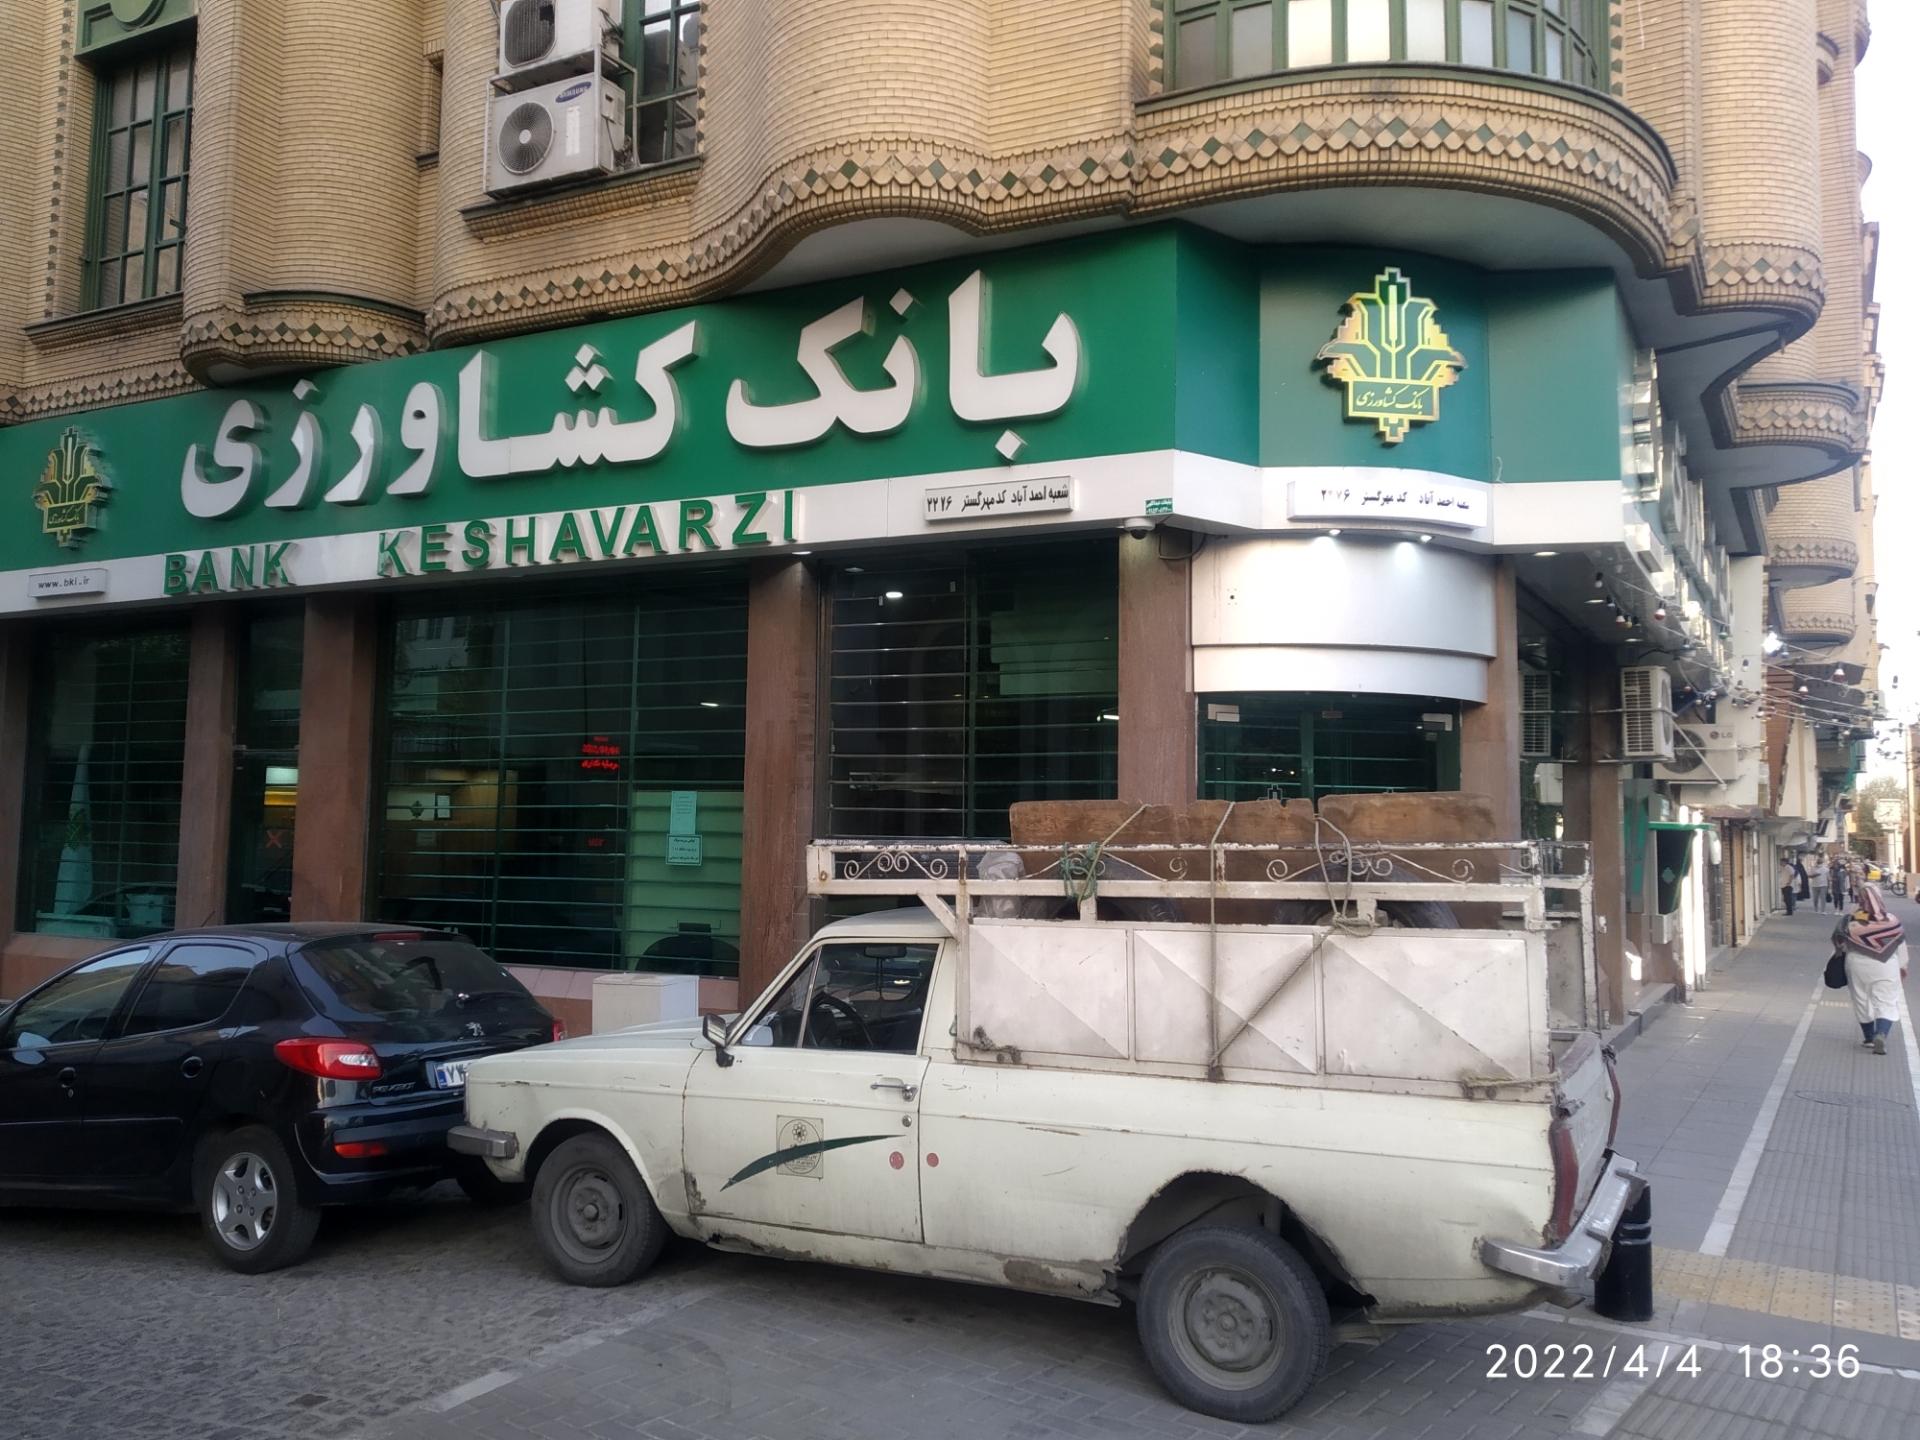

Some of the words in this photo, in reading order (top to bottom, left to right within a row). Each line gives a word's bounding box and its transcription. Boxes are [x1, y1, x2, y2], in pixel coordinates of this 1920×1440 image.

[726, 269, 1080, 461] بانک
[1356, 384, 1410, 408] کشاورزی
[1395, 386, 1430, 415] بانک
[181, 319, 699, 518] کشاورزی
[926, 495, 953, 512] ۲۲۷۶
[961, 490, 995, 512] مهرگستر
[996, 489, 1007, 504] کد
[1011, 485, 1027, 507] آباد
[1028, 485, 1047, 501] احمد
[1049, 484, 1069, 503] شعبه
[1397, 491, 1408, 503] کد
[1437, 495, 1455, 507] احمد
[163, 542, 294, 596] BANK
[377, 489, 800, 578] KESHAVARZI
